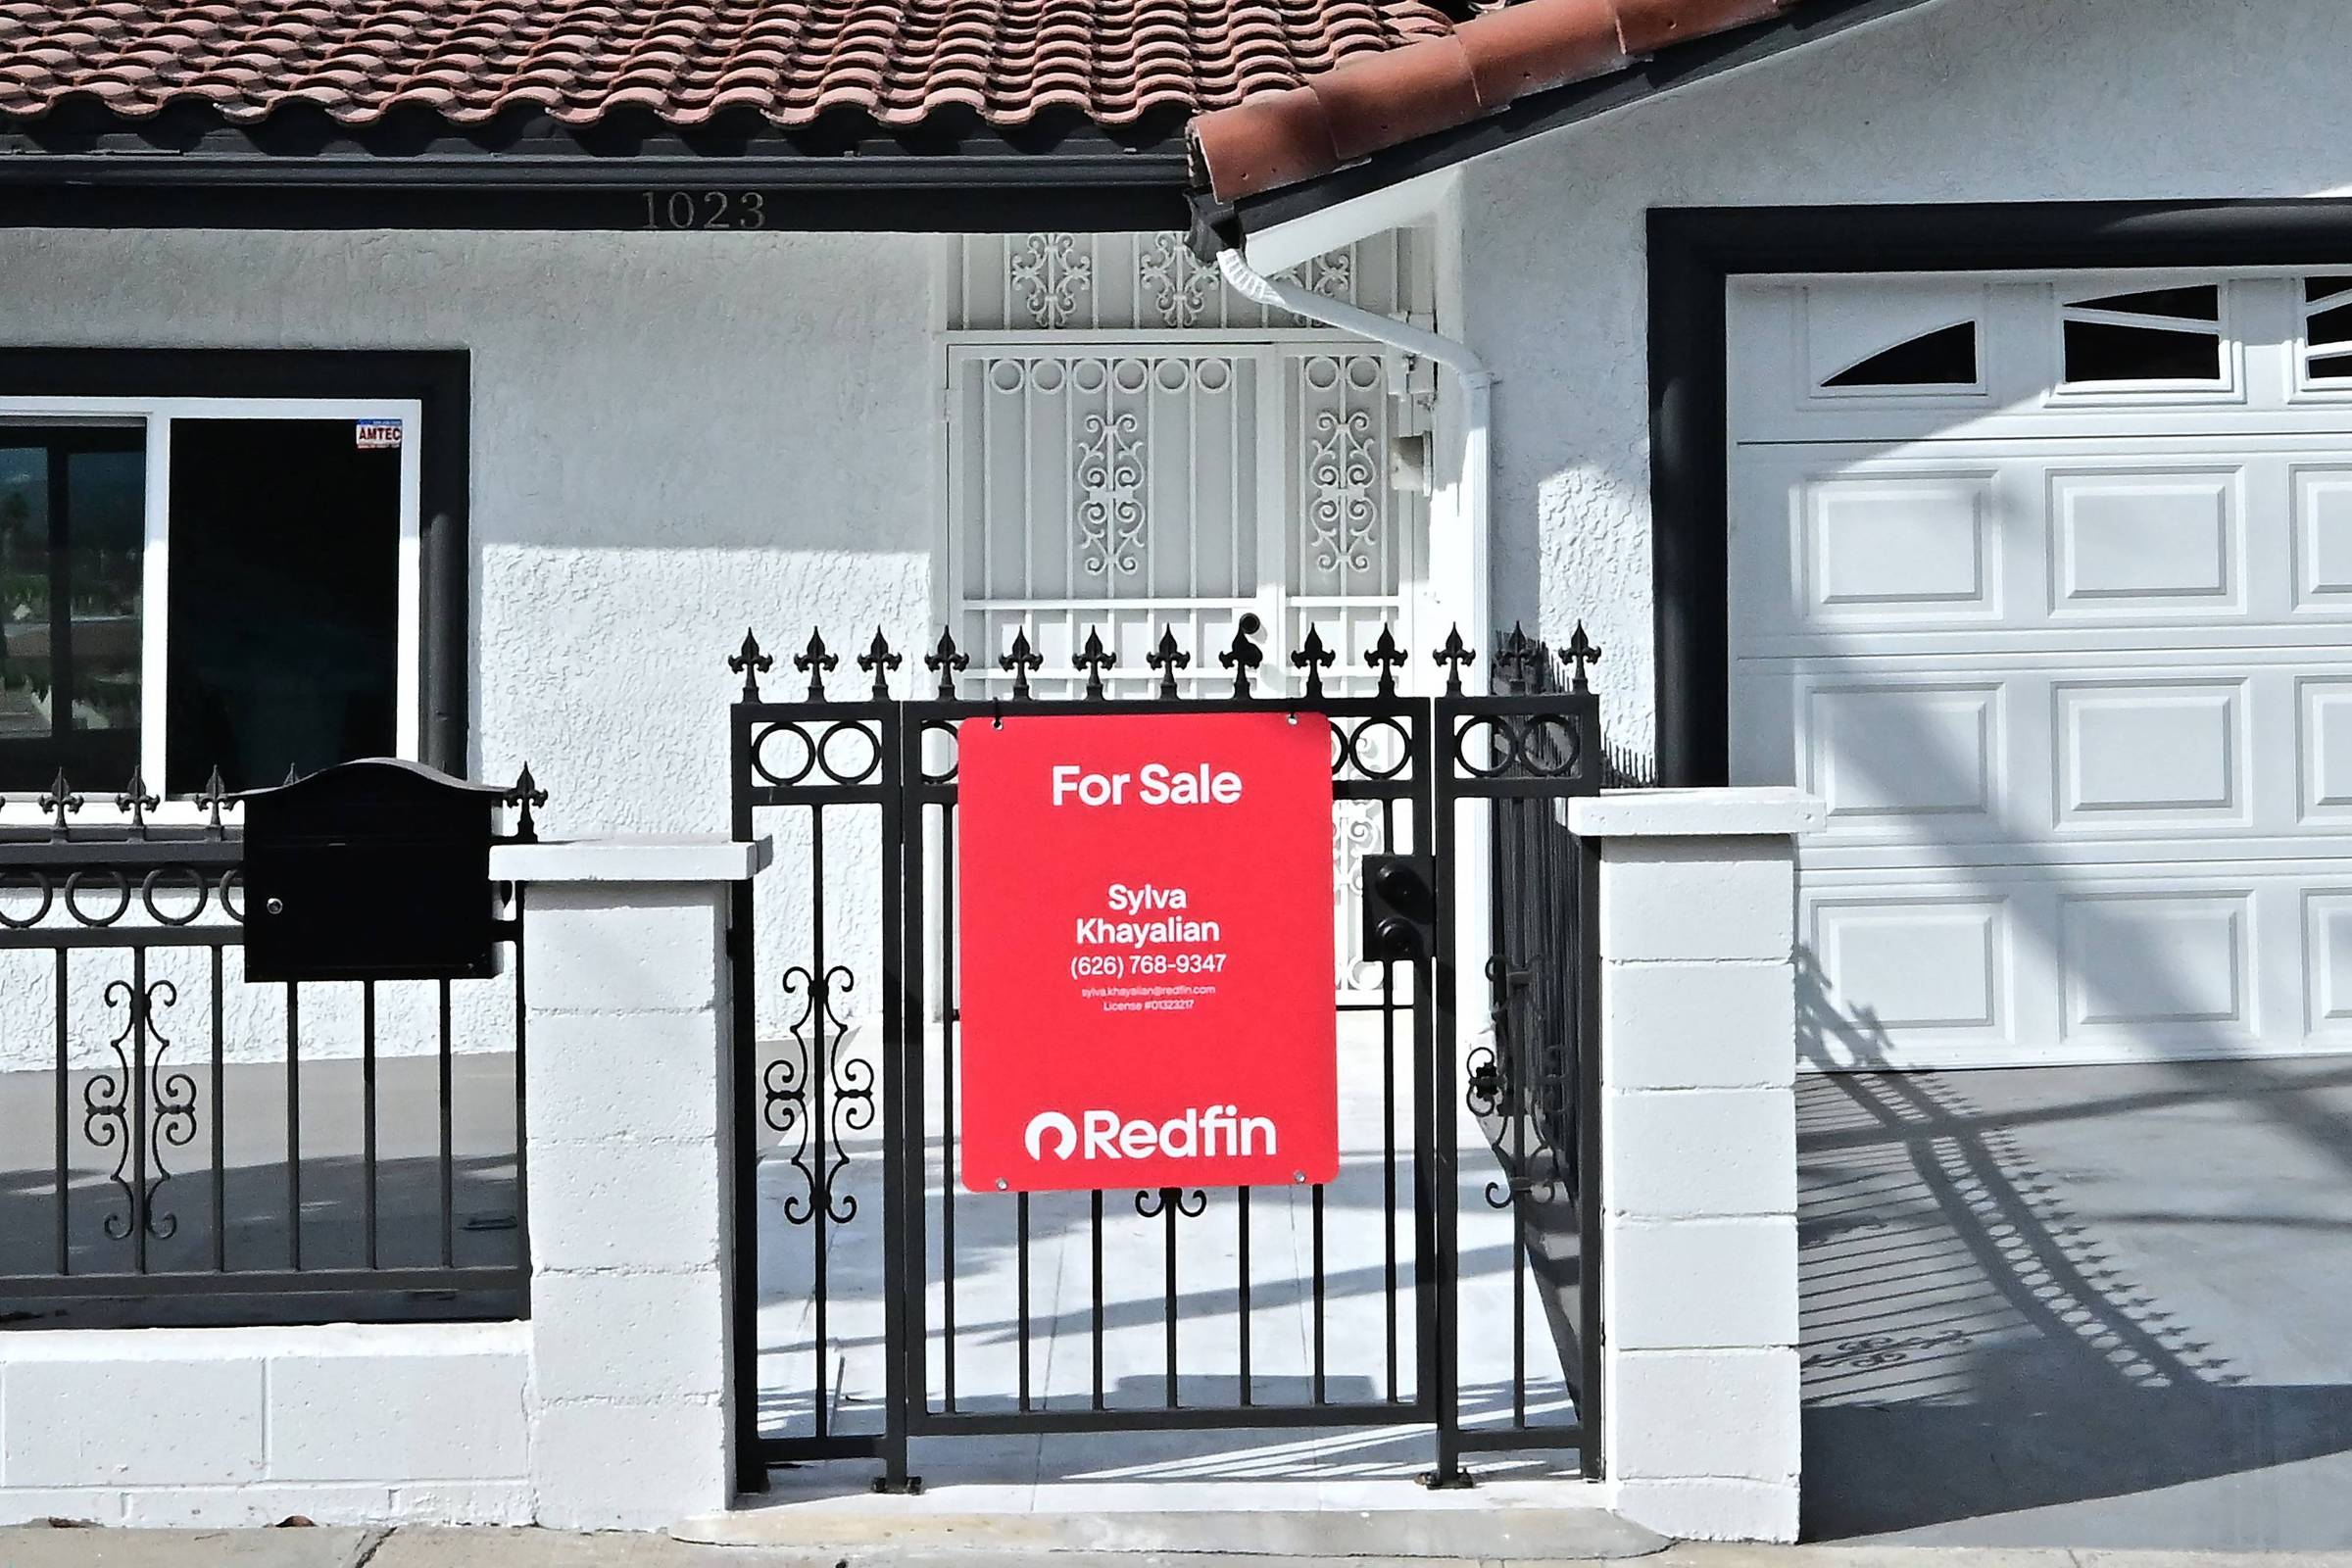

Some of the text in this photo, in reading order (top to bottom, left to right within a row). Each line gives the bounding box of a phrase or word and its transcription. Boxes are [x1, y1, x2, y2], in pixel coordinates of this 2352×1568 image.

[643, 191, 766, 229] 1023
[359, 427, 402, 440] AMTEC
[1052, 762, 1244, 807] For Sale
[1107, 883, 1188, 915] Sylva
[1076, 915, 1220, 949] Khayalian
[1070, 953, 1227, 980] (626) 768-9347
[1103, 1001, 1143, 1011] License
[1083, 1104, 1277, 1160] Redfin
